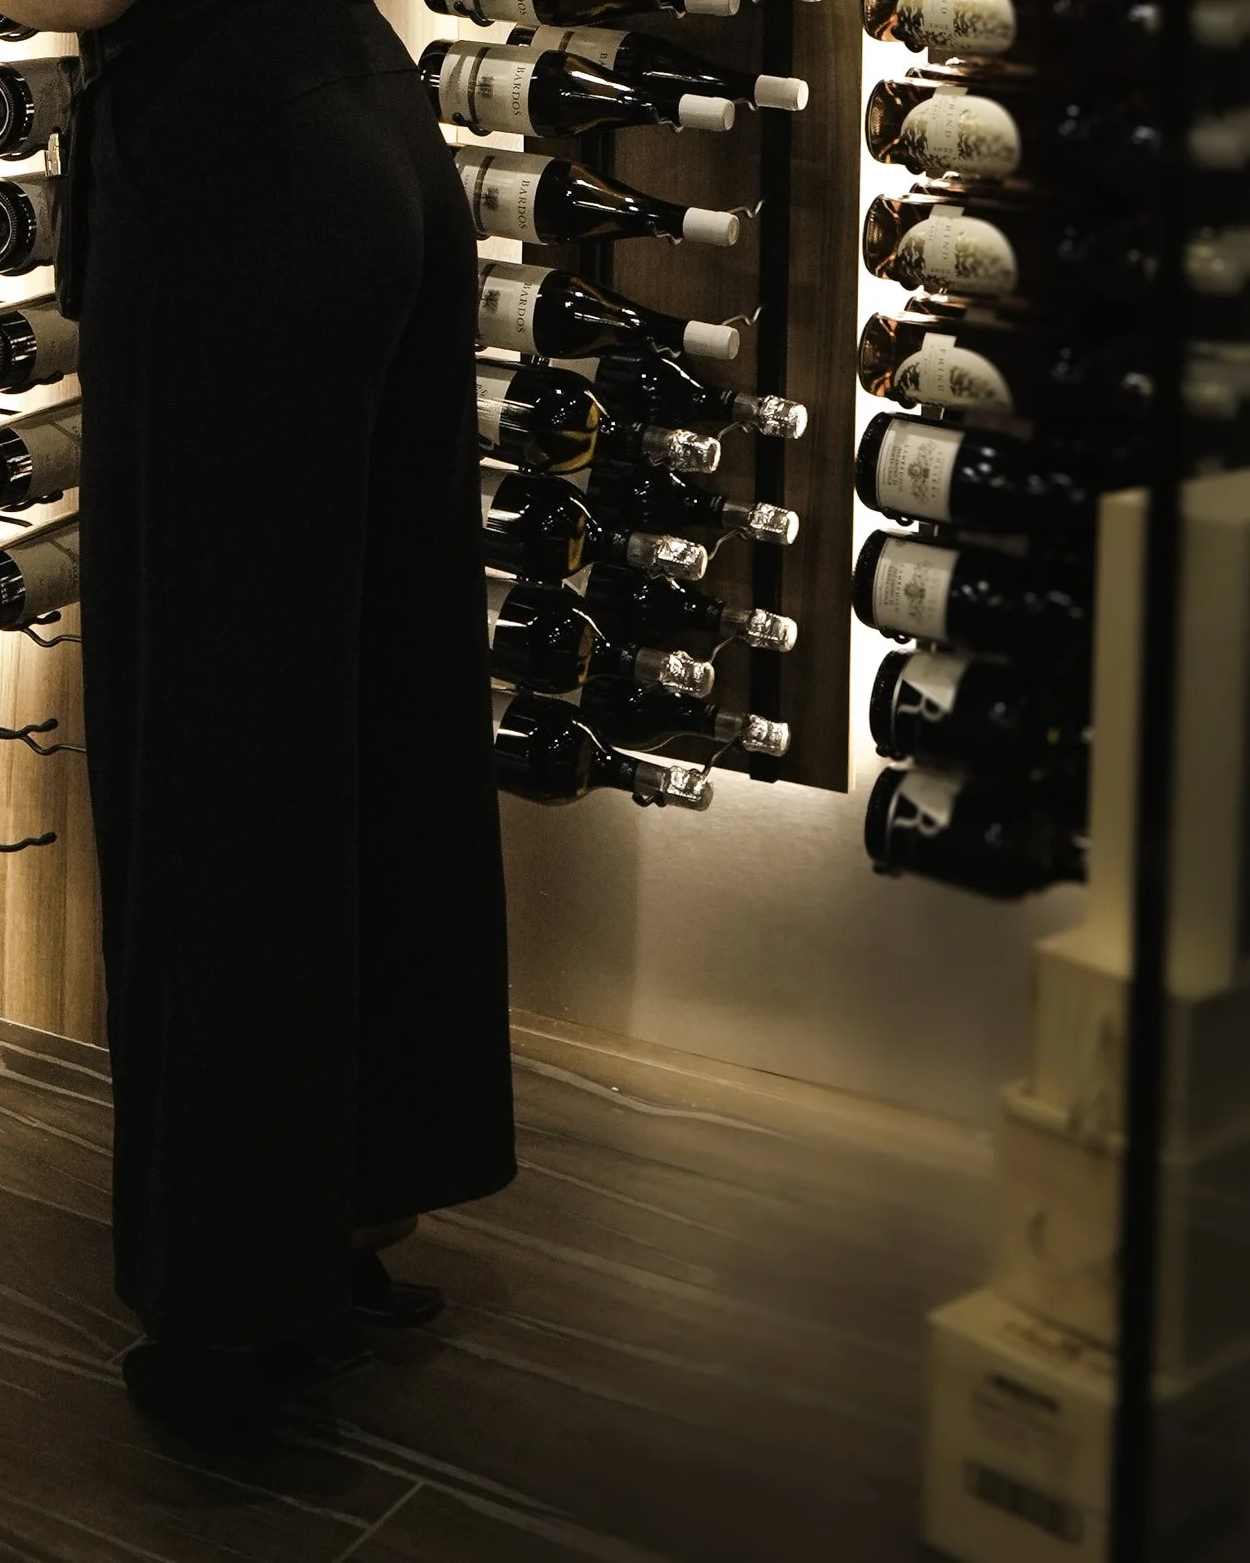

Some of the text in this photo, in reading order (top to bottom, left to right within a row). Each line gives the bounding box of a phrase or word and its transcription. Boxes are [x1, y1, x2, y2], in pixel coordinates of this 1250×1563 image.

[511, 66, 526, 118] BARDOS
[517, 179, 531, 231] BARDOS
[941, 224, 951, 261] RIND
[516, 282, 531, 334] BARDOS
